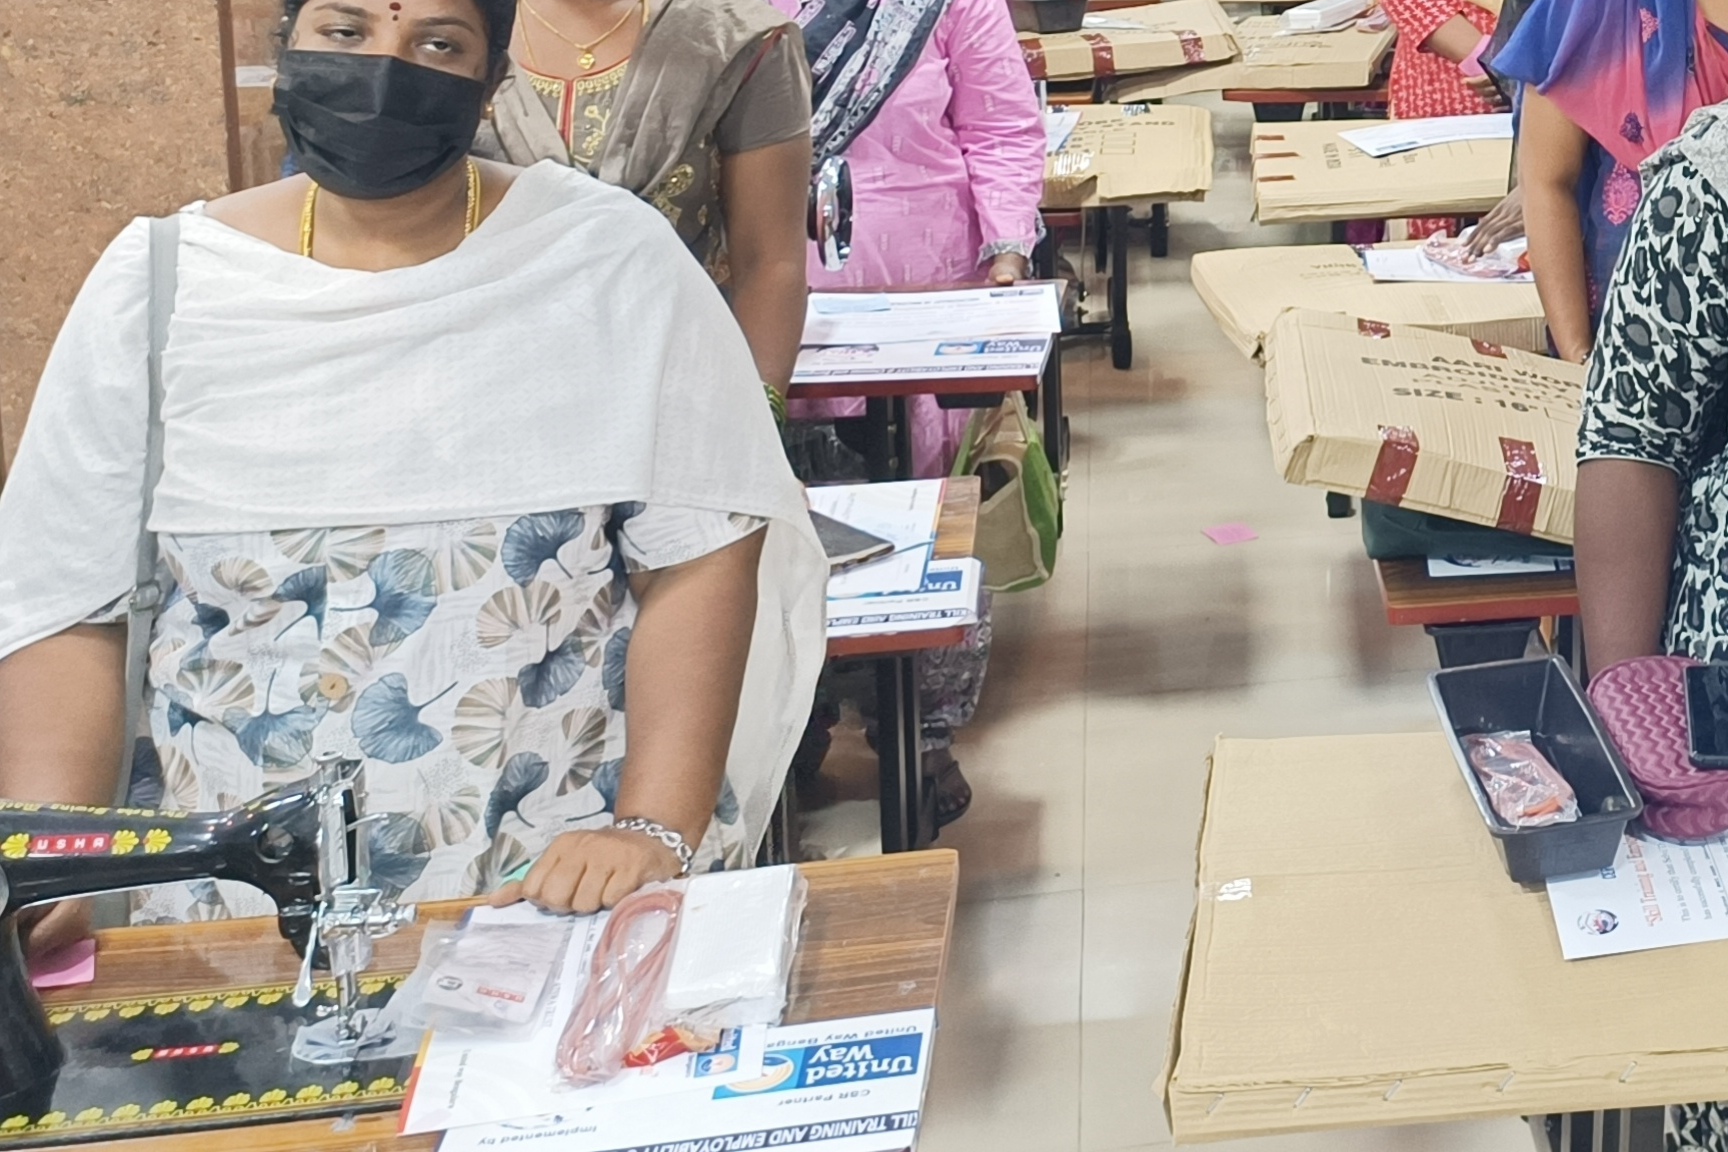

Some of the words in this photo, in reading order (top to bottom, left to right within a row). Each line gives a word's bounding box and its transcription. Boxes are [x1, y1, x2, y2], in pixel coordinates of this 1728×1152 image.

[1432, 356, 1503, 372] AARI
[1361, 356, 1570, 394] EMBROIDERY
[1392, 387, 1464, 401] SIZE
[37, 835, 105, 850] USHA
[808, 1044, 875, 1065] Way
[805, 1057, 914, 1085] United
[768, 1124, 811, 1145] AND
[810, 1114, 887, 1139] TRAINING
